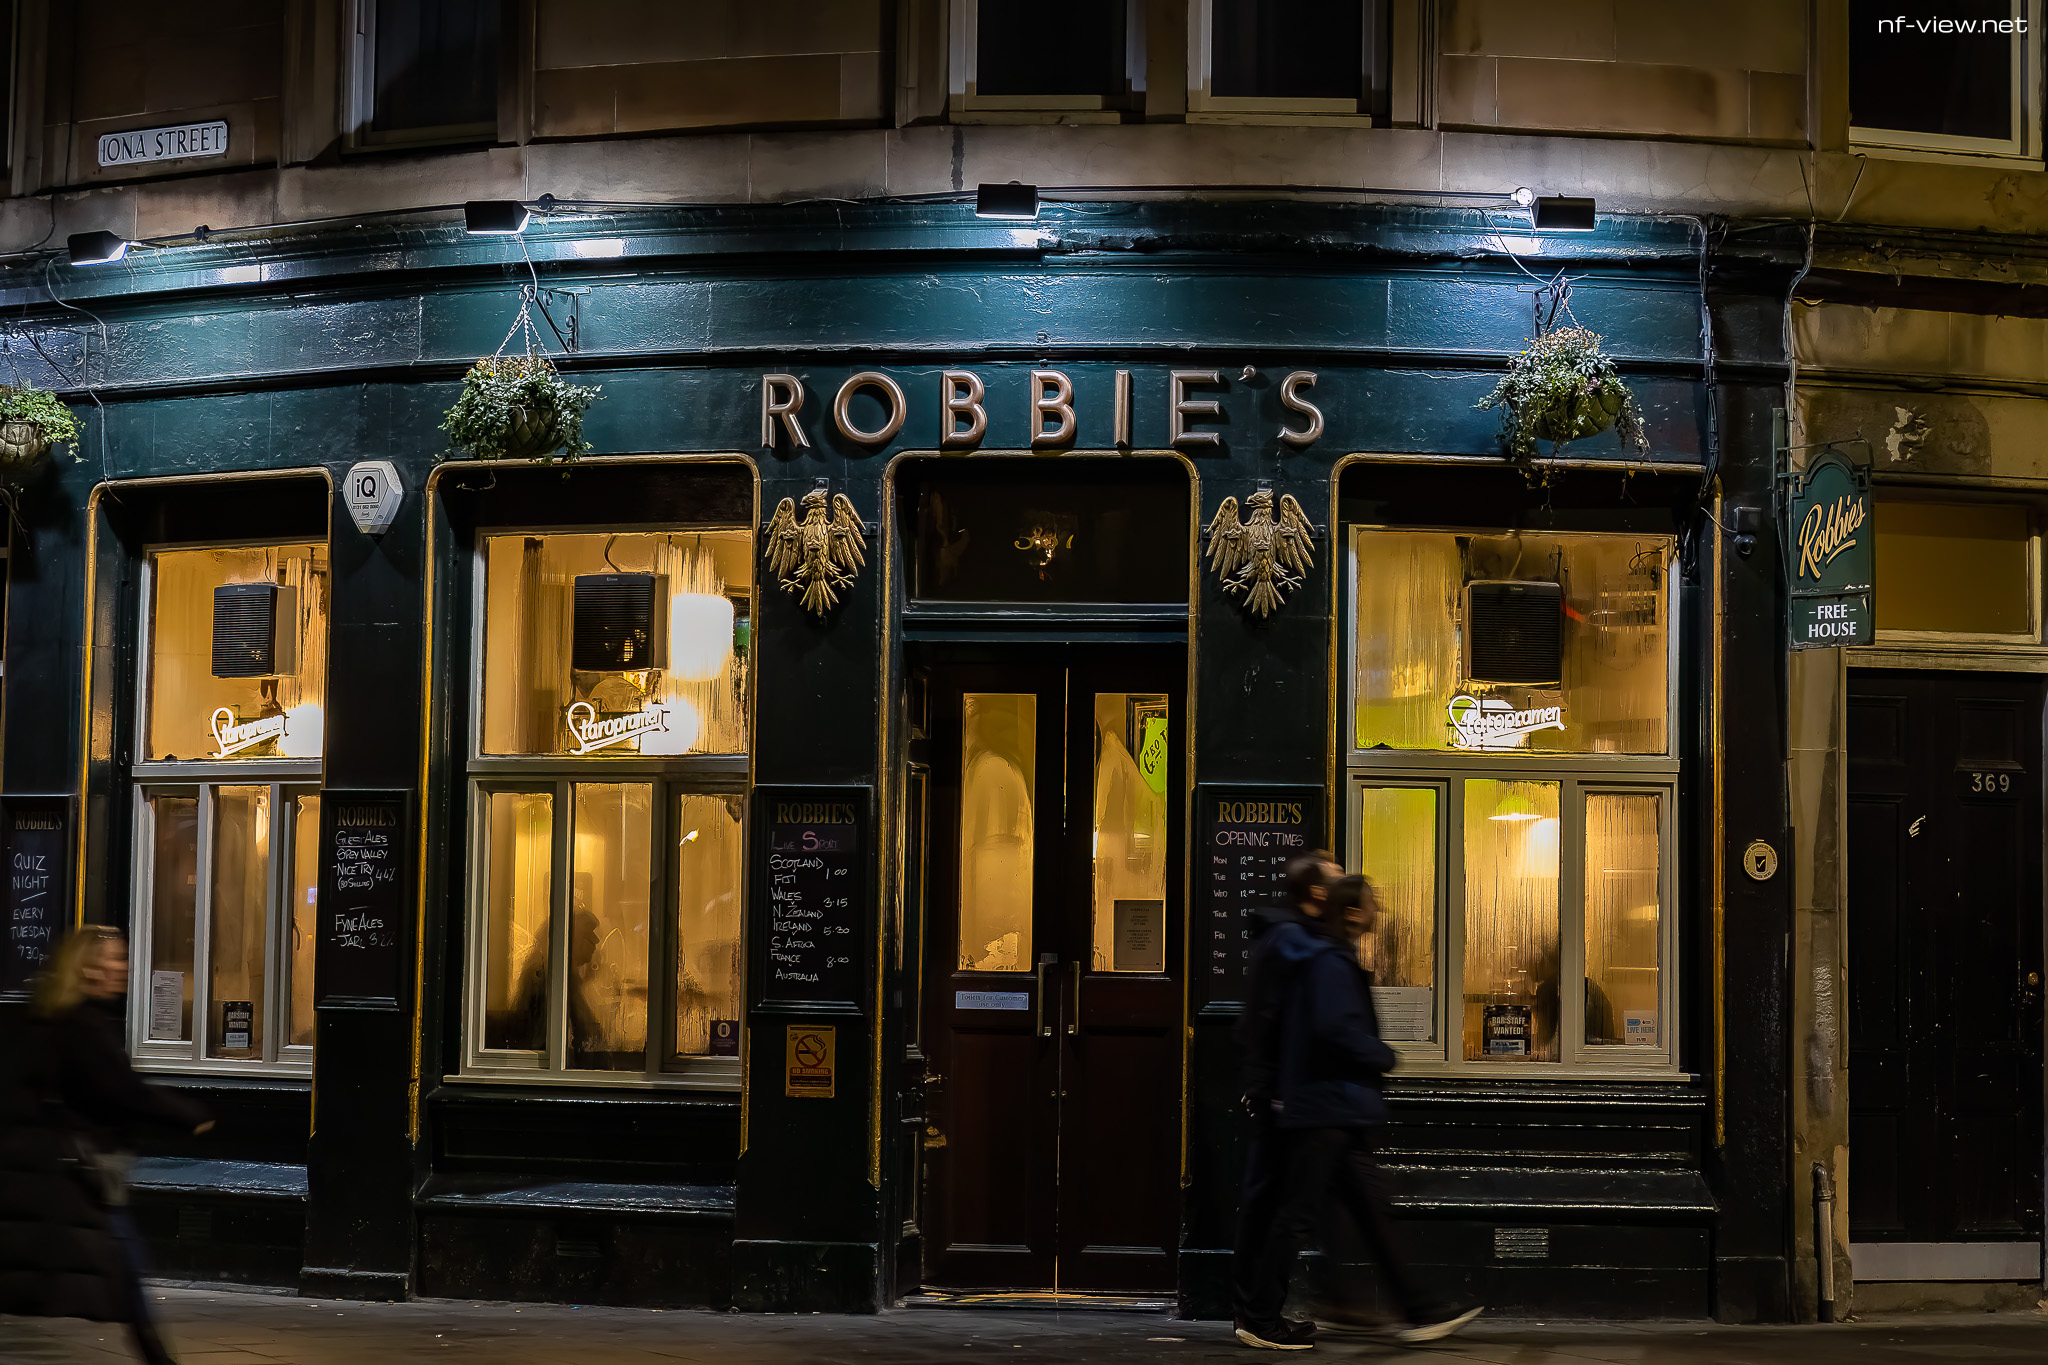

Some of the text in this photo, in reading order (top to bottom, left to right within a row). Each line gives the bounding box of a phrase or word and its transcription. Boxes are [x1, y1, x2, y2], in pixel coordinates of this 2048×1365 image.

[102, 126, 223, 162] IONA STREET
[761, 364, 1325, 448] ROBBIE'S
[356, 475, 375, 498] iQ
[1798, 494, 1866, 579] Robbies
[1808, 621, 1857, 638] HOUSE
[1971, 772, 2010, 793] 369
[337, 806, 397, 827] ROBBIE'S
[776, 802, 855, 825] ROBBIE'S
[1217, 801, 1302, 825] ROBBIE'S
[364, 830, 388, 844] ALES
[770, 830, 839, 851] LIVE SPORT
[1215, 831, 1304, 847] OPENING TIMES
[360, 848, 388, 860] VALLEY
[1213, 855, 1227, 865] MON
[13, 853, 47, 871] QUIZ
[355, 861, 374, 875] TRY
[769, 854, 824, 870] SCOTLAND
[12, 875, 49, 890] NIGHT
[1213, 872, 1226, 881] TUE
[770, 886, 802, 901] WALES
[13, 907, 44, 920] EVERY
[785, 905, 824, 920] ZEALAND
[335, 912, 384, 932] FYNE ALES
[773, 917, 812, 932] IRELAND
[10, 926, 51, 941] TUESDAY
[1214, 931, 1226, 940] FRI
[785, 937, 815, 948] AFRICA
[770, 948, 801, 963] FRANCE
[1213, 950, 1226, 959] SAT
[775, 968, 819, 982] AUSTRALIA
[1212, 966, 1225, 975] SUN
[1491, 1016, 1526, 1025] BAR STAFF
[1493, 1026, 1524, 1035] WANTED!
[1641, 1026, 1655, 1034] HERE
